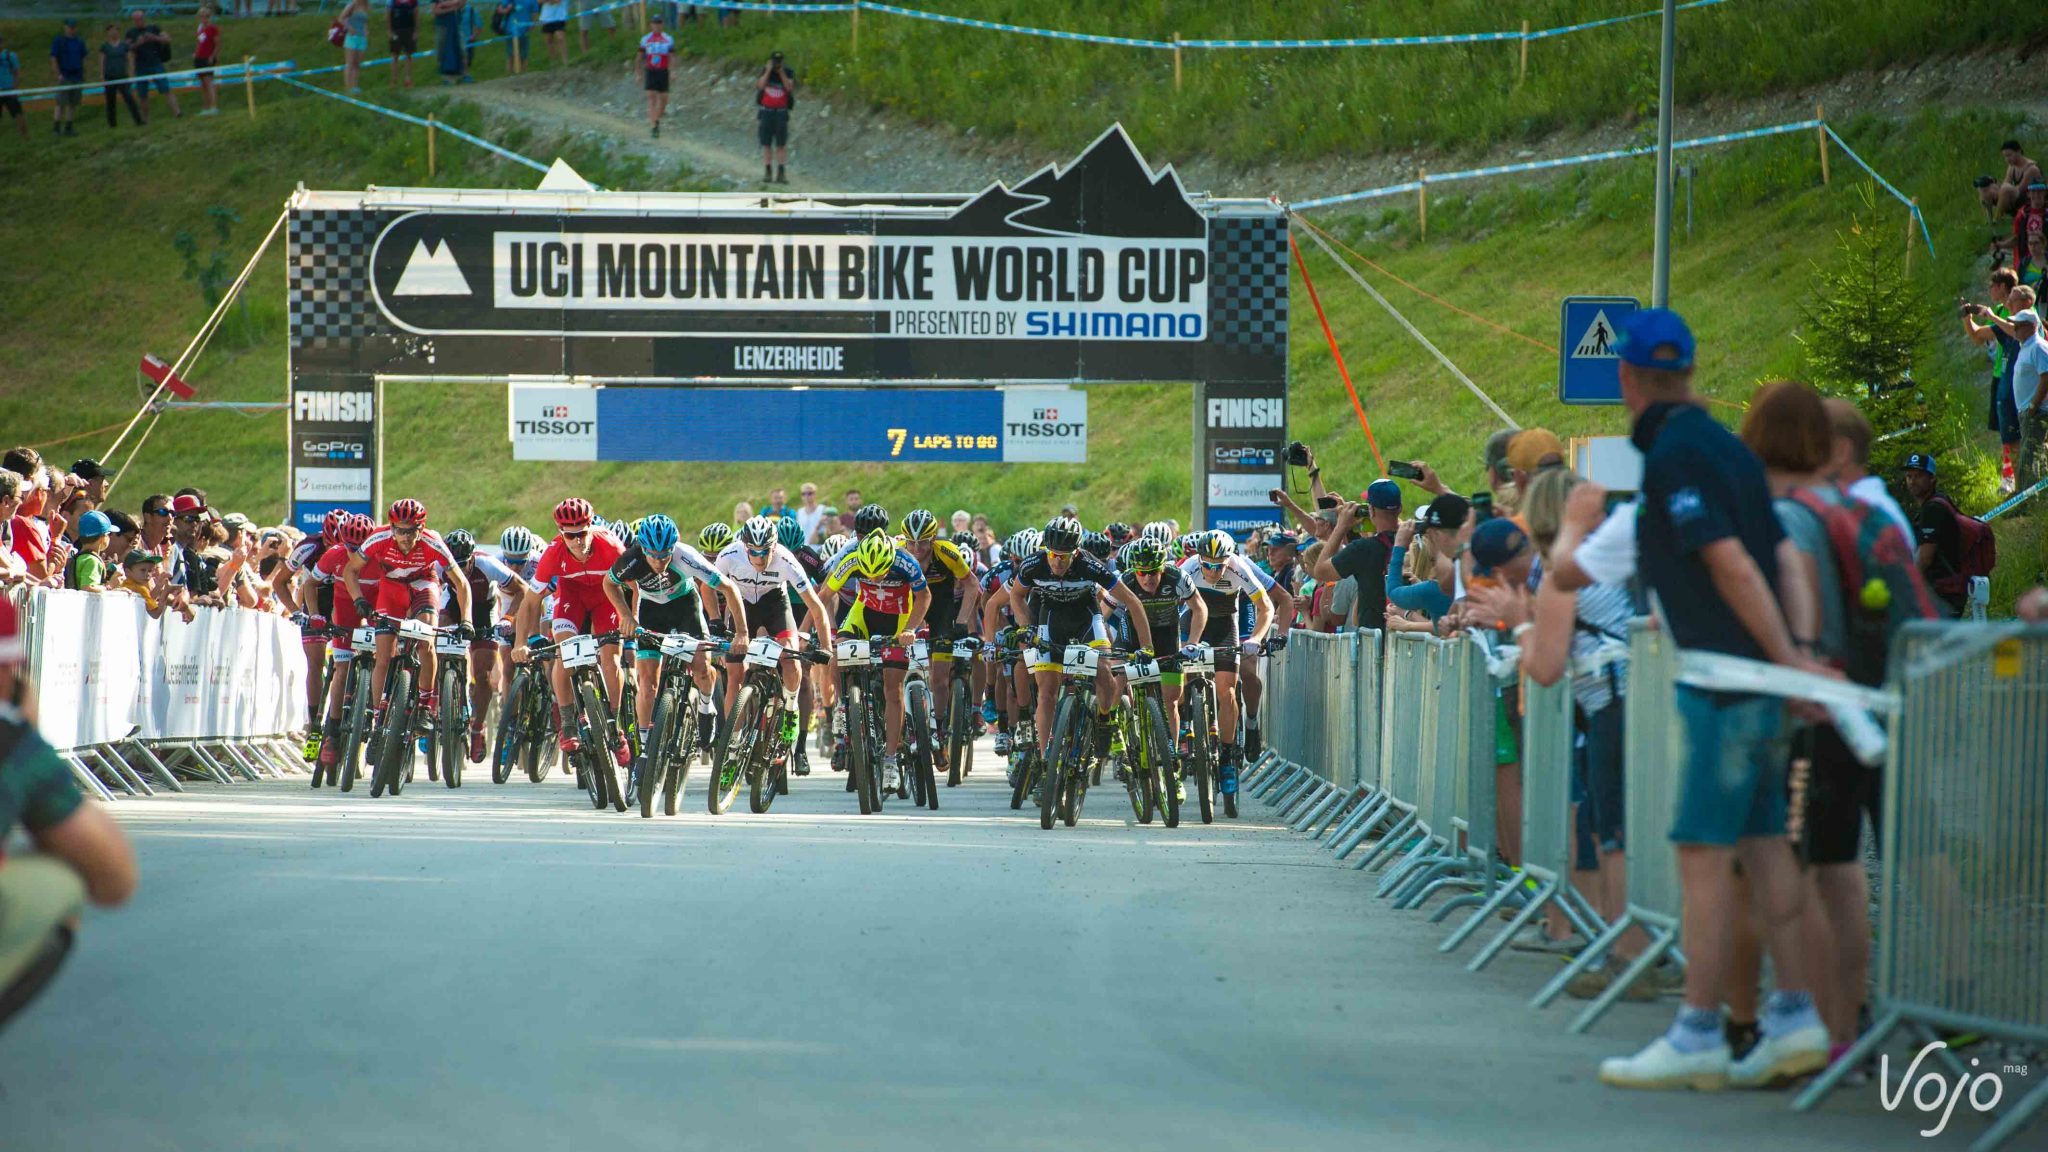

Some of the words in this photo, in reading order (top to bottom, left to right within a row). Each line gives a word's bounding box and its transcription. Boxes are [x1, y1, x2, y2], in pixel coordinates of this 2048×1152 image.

[510, 241, 583, 298] UCI
[597, 242, 825, 300] MOUNTAIN
[838, 245, 934, 301] BIKE
[951, 246, 1105, 303] WORLD
[1117, 246, 1206, 304] CUP
[895, 310, 991, 336] PRESENTED
[996, 311, 1018, 336] BY
[1026, 311, 1202, 339] SHIMANO
[733, 345, 844, 372] LENZERHEIDE
[294, 391, 373, 422] FINISH
[1207, 398, 1284, 428] FINISH
[516, 421, 595, 434] TISSOT
[1006, 423, 1085, 437] TISSOT
[302, 440, 364, 452] GoPro
[887, 428, 907, 456] 7
[913, 435, 953, 449] LAPS
[955, 435, 975, 449] TO
[976, 435, 998, 449] GO
[1215, 447, 1275, 458] GoPro
[364, 631, 373, 643] 5
[573, 642, 580, 656] 7
[761, 643, 769, 655] 1
[849, 644, 858, 658] 2
[1077, 650, 1086, 664] 8
